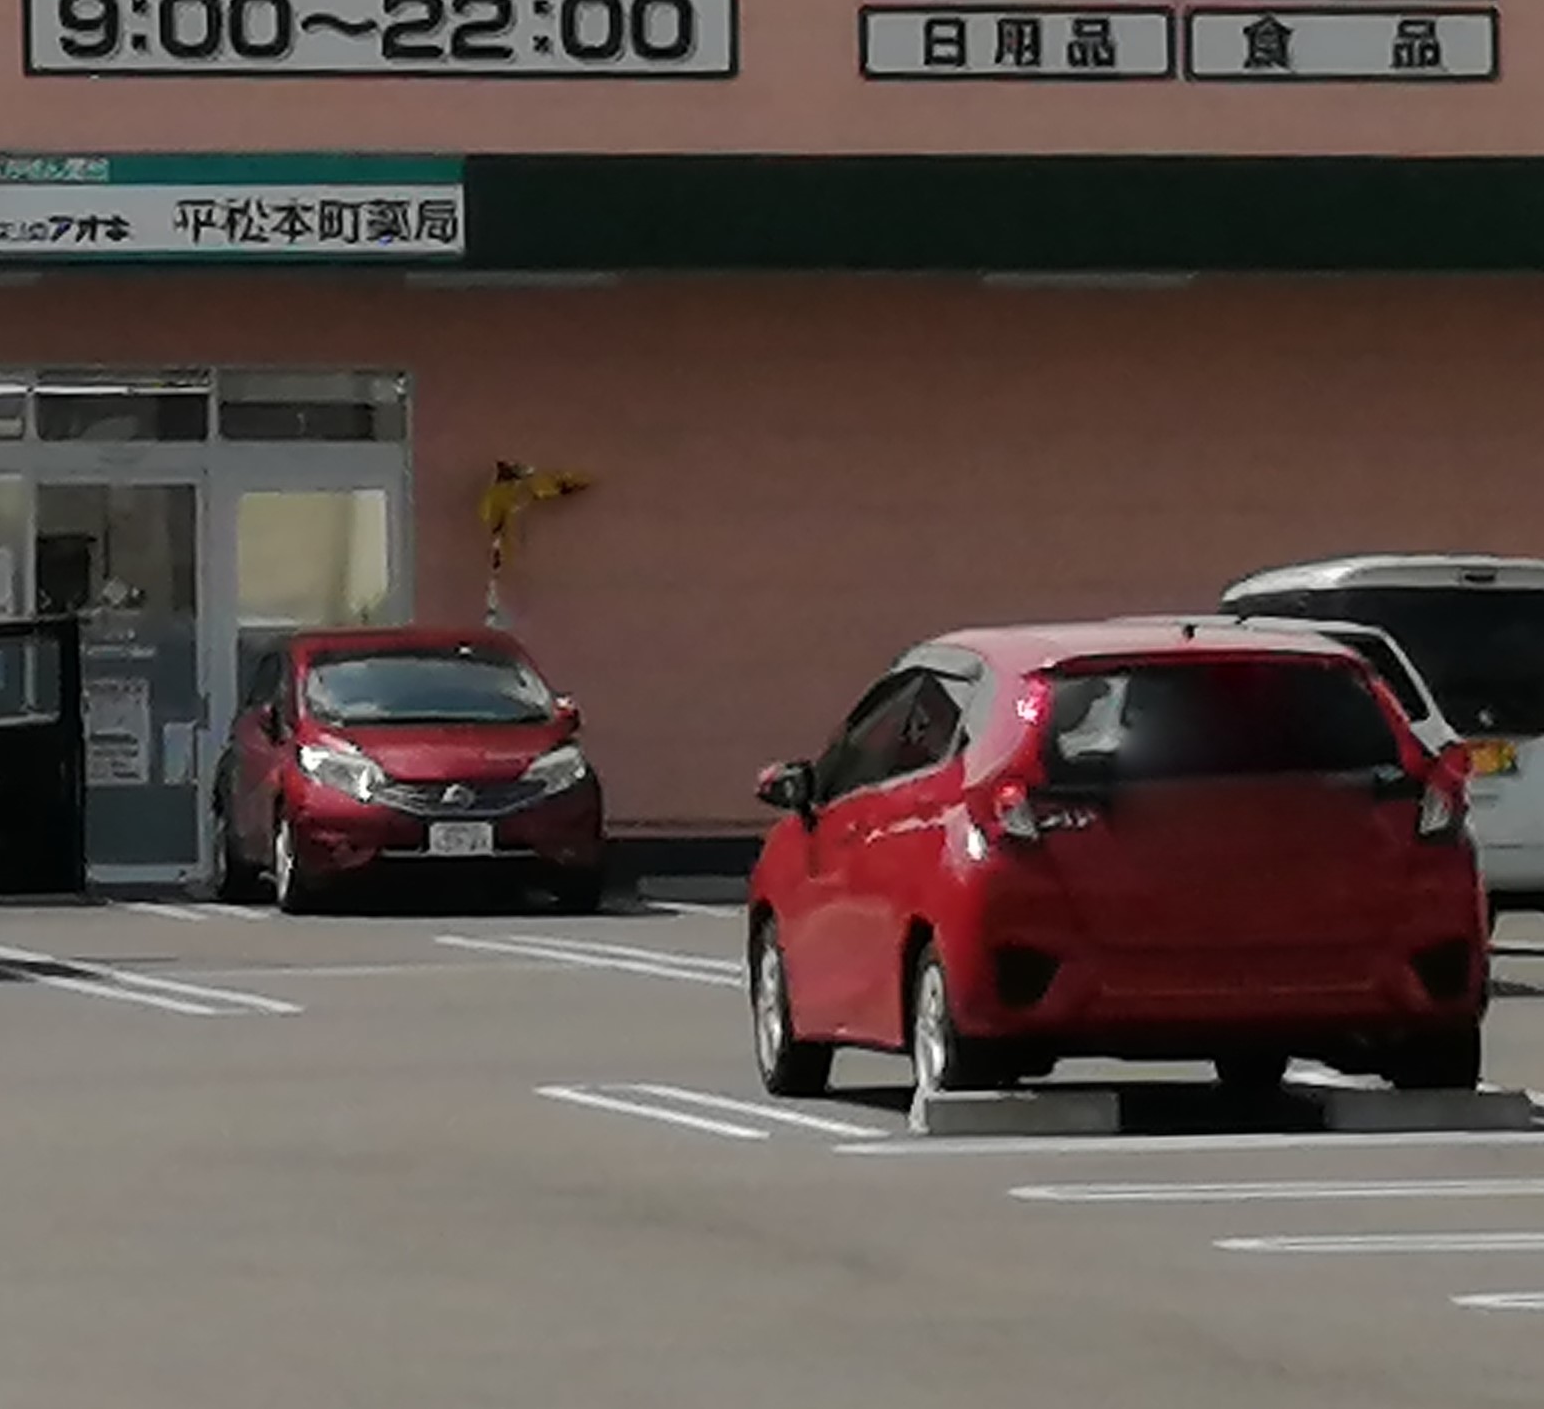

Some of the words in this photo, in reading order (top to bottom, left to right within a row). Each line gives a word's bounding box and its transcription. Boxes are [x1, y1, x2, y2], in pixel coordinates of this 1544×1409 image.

[923, 18, 1117, 69] 日用品
[175, 198, 460, 245] 平松本町薬局
